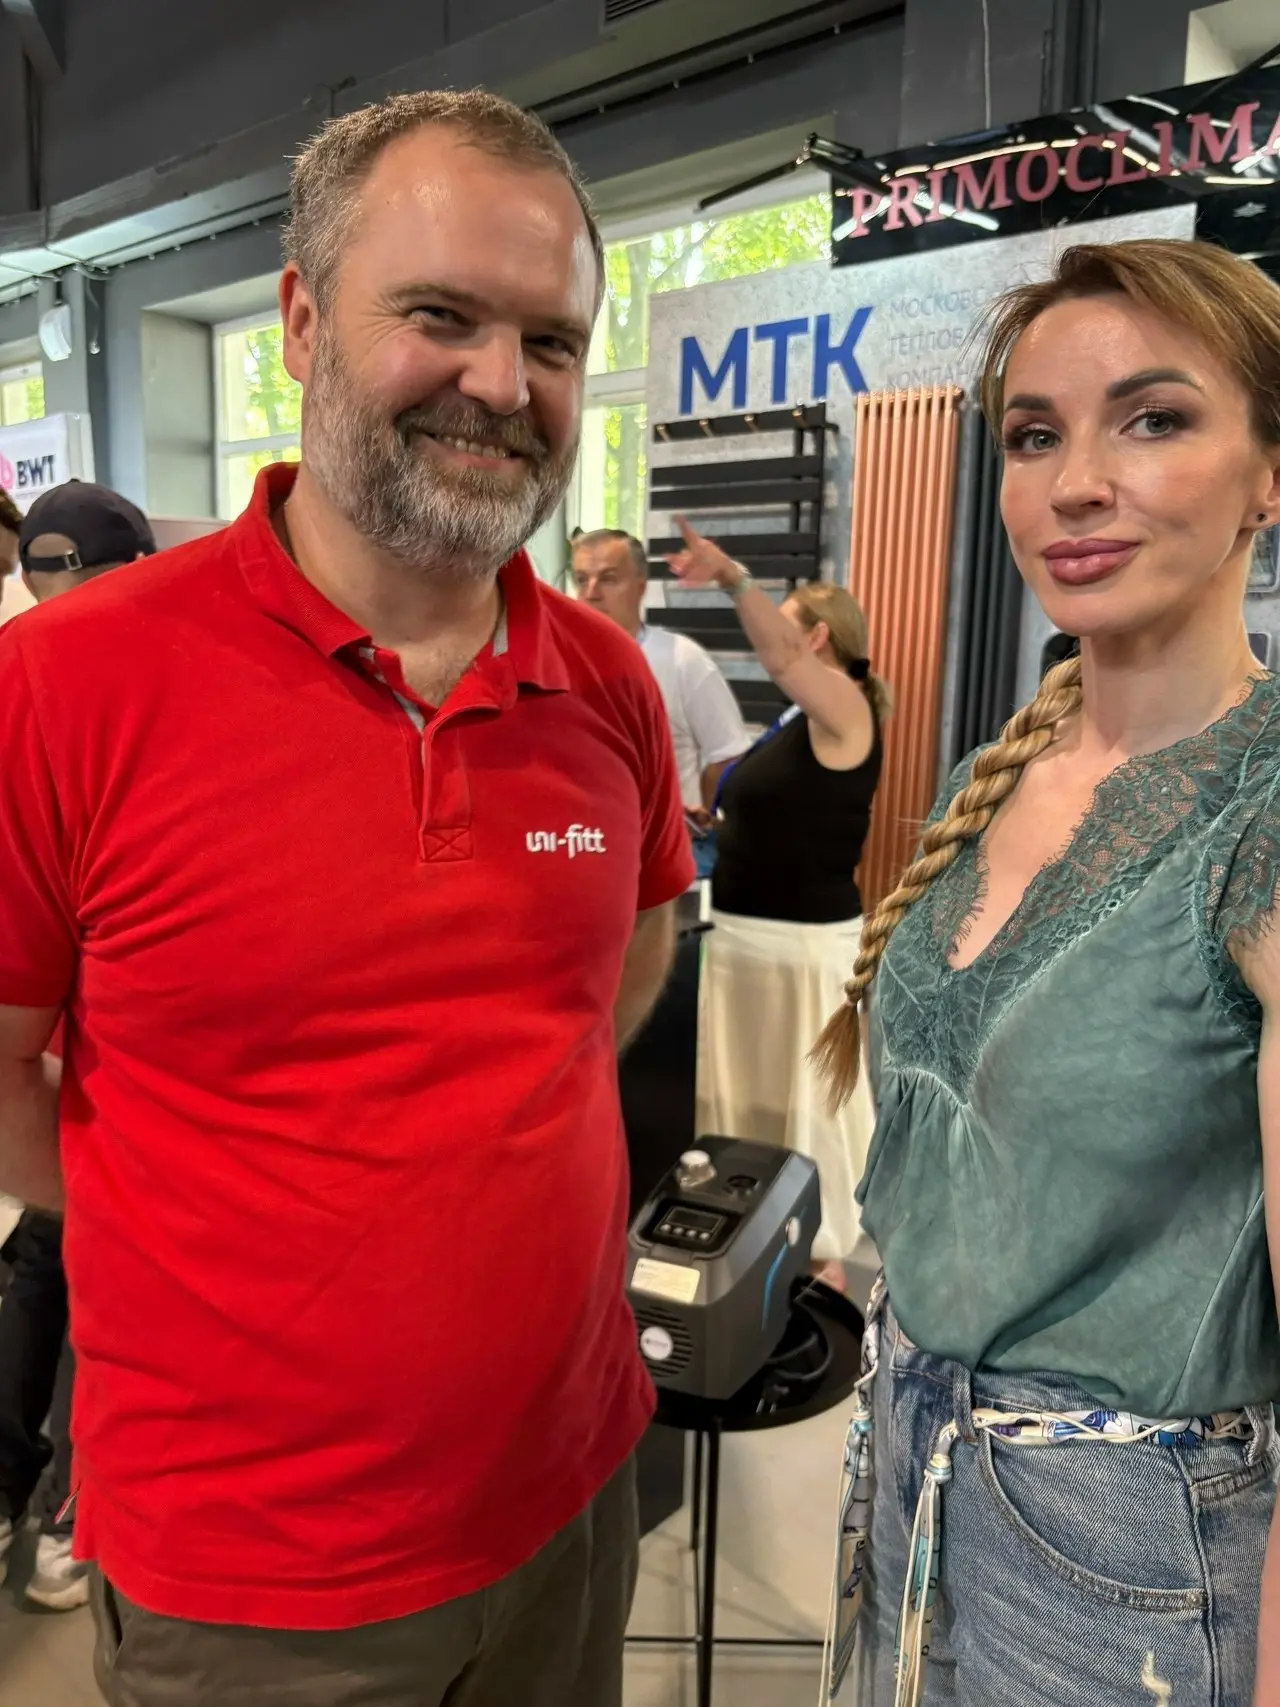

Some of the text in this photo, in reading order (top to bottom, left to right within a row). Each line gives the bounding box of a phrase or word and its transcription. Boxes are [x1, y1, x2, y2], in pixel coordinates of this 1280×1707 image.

[888, 324, 980, 356] ТЕПЛОВ
[679, 305, 876, 416] МТК
[16, 454, 56, 487] BWT
